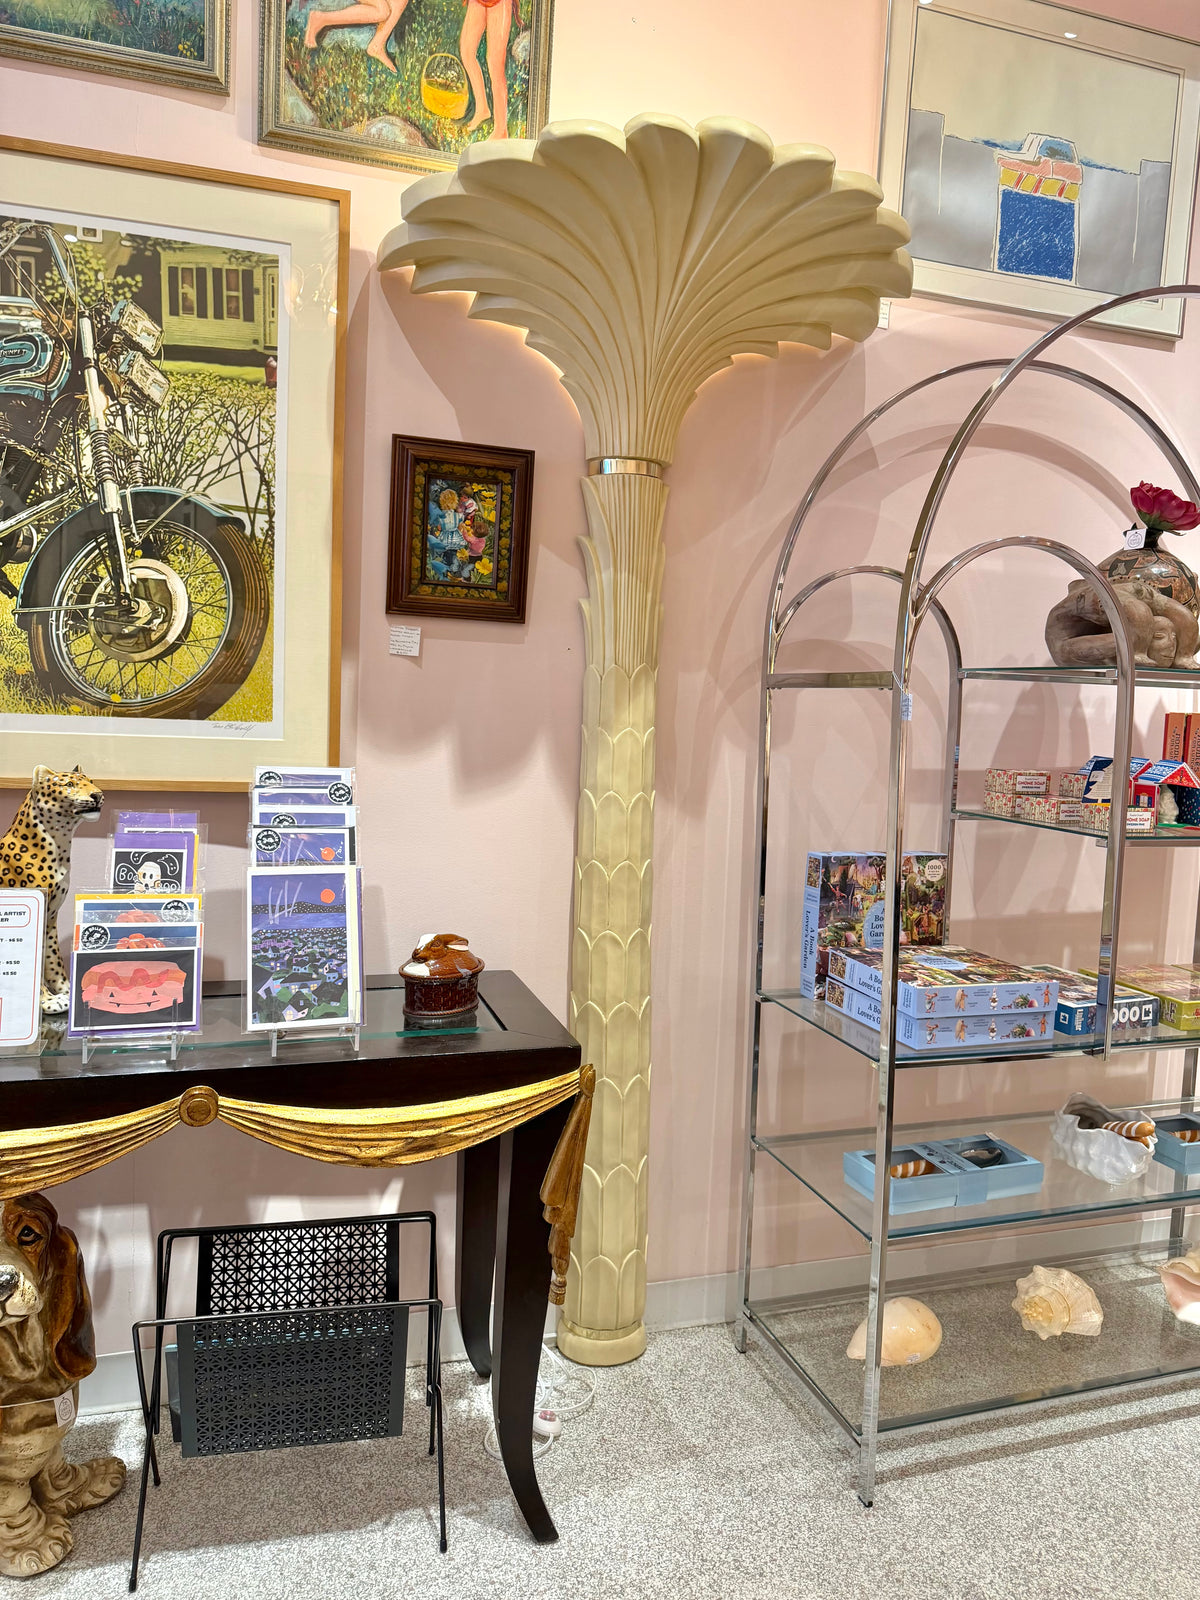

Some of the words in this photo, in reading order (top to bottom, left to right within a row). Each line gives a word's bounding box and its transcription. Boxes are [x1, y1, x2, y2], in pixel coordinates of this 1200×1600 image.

[868, 973, 873, 981] A
[858, 977, 876, 993] Lover's
[857, 1007, 876, 1022] Lover's
[867, 1003, 872, 1011] A
[1112, 1006, 1140, 1024] 000
